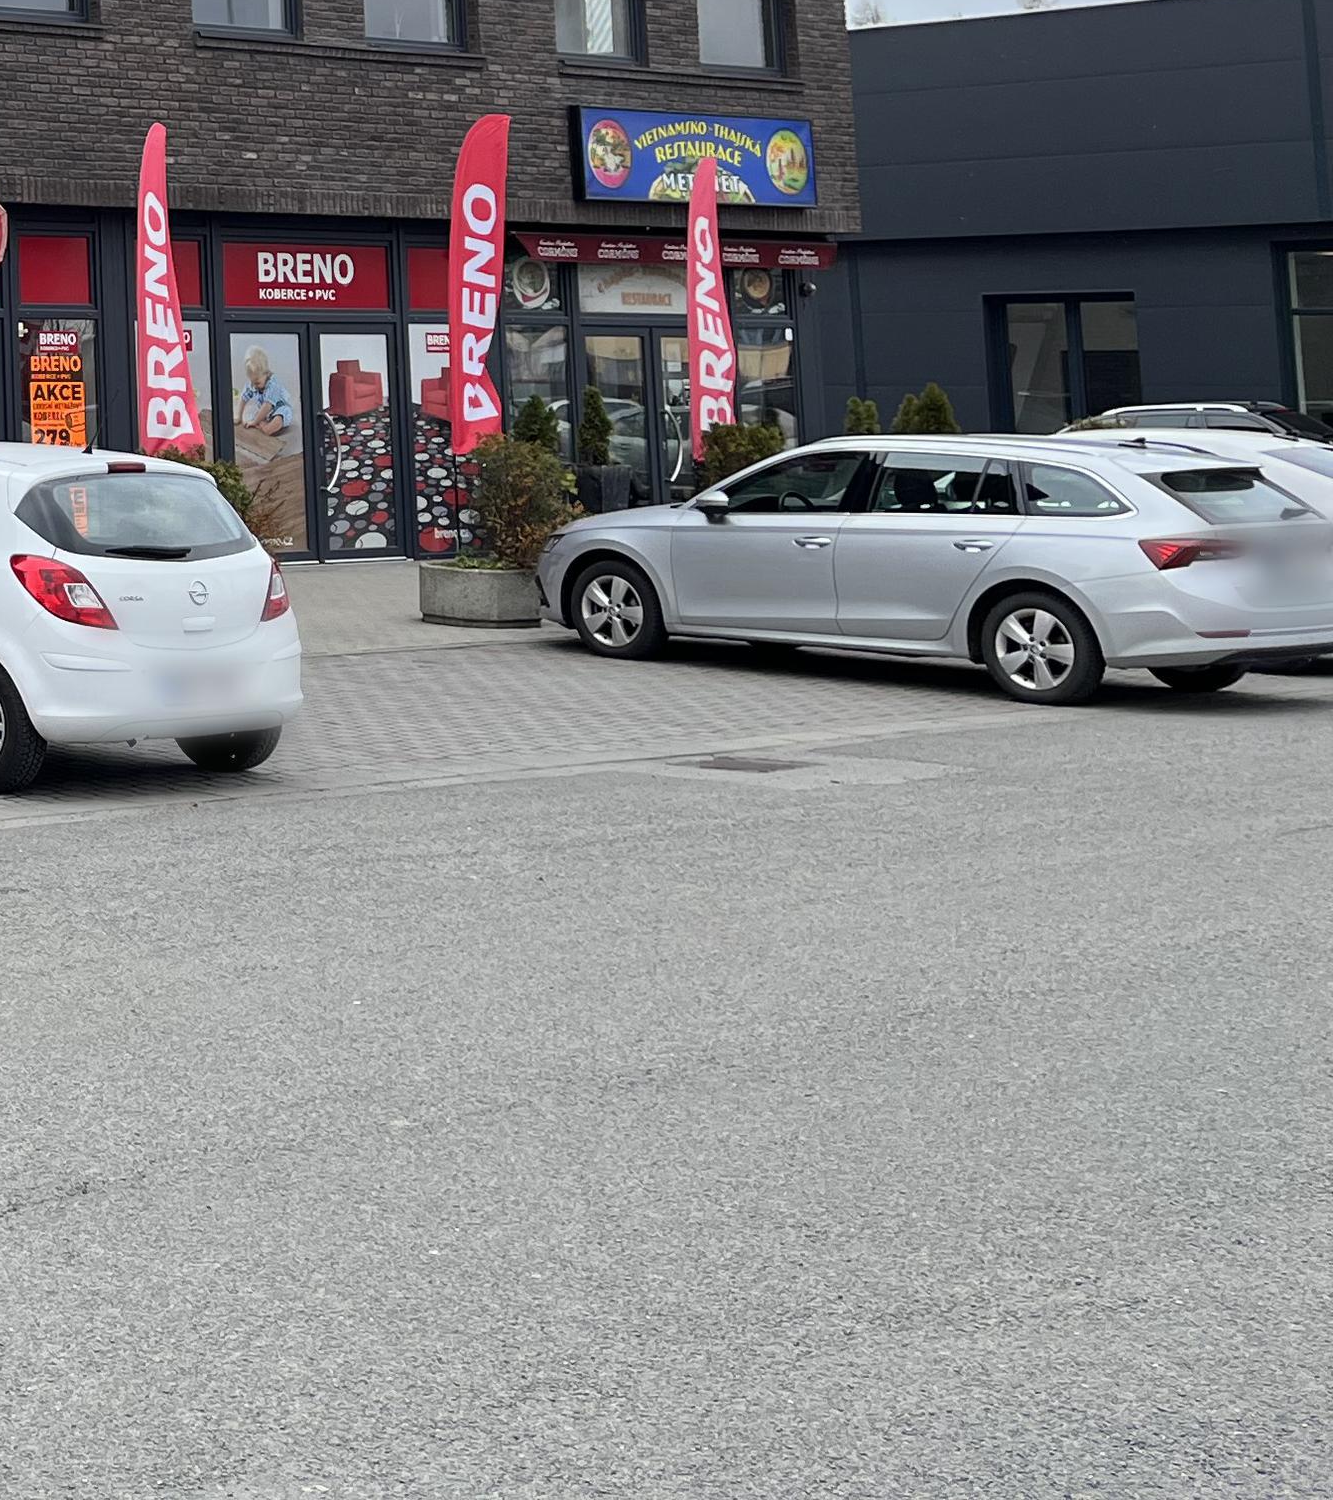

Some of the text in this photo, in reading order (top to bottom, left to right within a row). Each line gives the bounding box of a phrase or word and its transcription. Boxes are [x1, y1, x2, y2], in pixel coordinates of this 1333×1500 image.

[654, 140, 743, 167] RESTAURACE
[257, 251, 355, 285] BRENO
[258, 288, 336, 301] KOBERCE PVC
[462, 182, 499, 422] BRENO
[143, 190, 195, 441] BRENO
[693, 215, 734, 433] BRENO
[39, 333, 77, 345] BRENO
[427, 334, 450, 346] BREN
[30, 355, 83, 372] BRENO
[32, 384, 82, 401] AKCE
